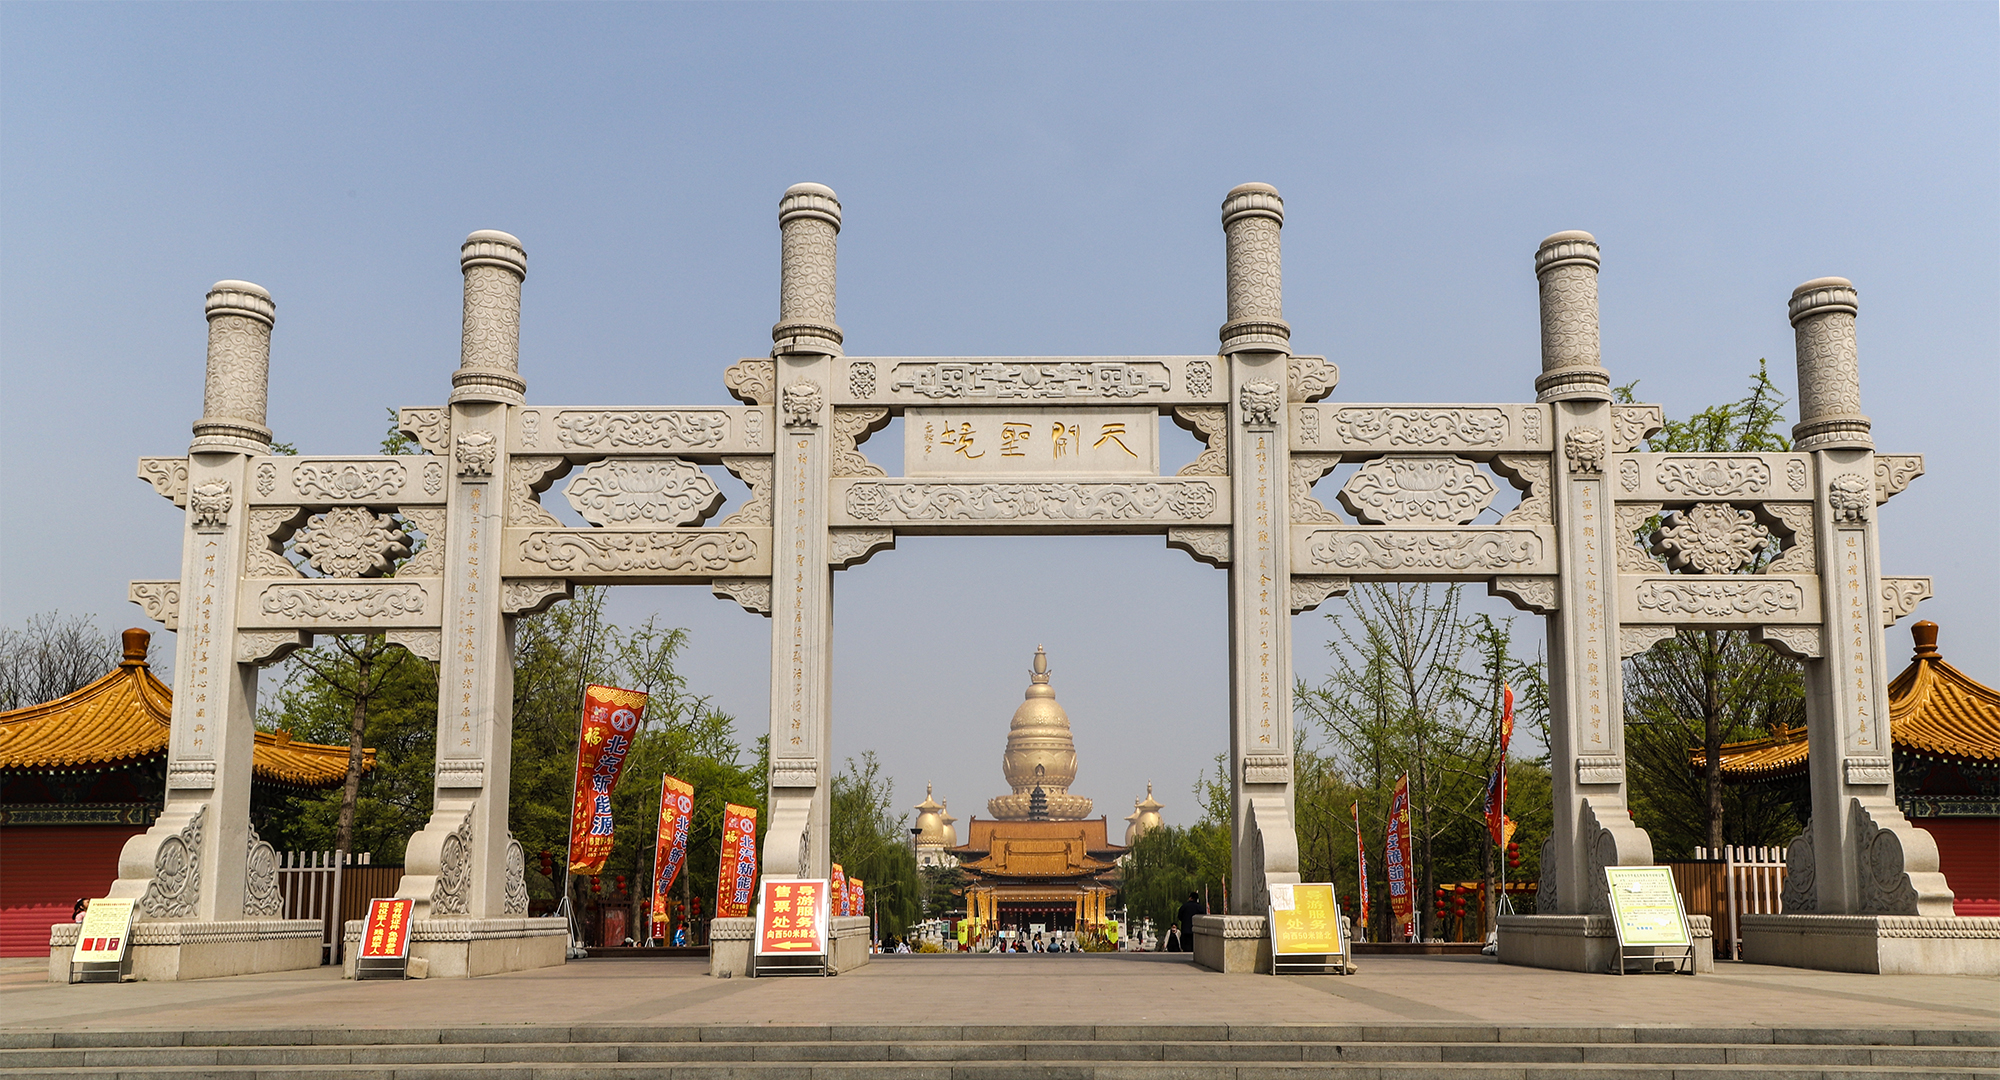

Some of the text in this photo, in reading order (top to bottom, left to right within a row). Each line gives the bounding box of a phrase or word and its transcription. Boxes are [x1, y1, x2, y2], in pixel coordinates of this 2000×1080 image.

[583, 726, 603, 748] 福
[590, 733, 628, 837] 北汽新能源
[661, 808, 675, 824] 福
[724, 830, 738, 844] 福
[657, 814, 690, 895] 北汽新能源
[733, 834, 756, 904] 北汽新能源
[374, 902, 390, 928] 现役军人
[771, 885, 792, 929] 售票处
[795, 886, 815, 928] 导游服务
[1305, 890, 1327, 930] 导游服务
[767, 929, 817, 939] 向西50米路北
[1282, 931, 1332, 940] 向西50米路北
